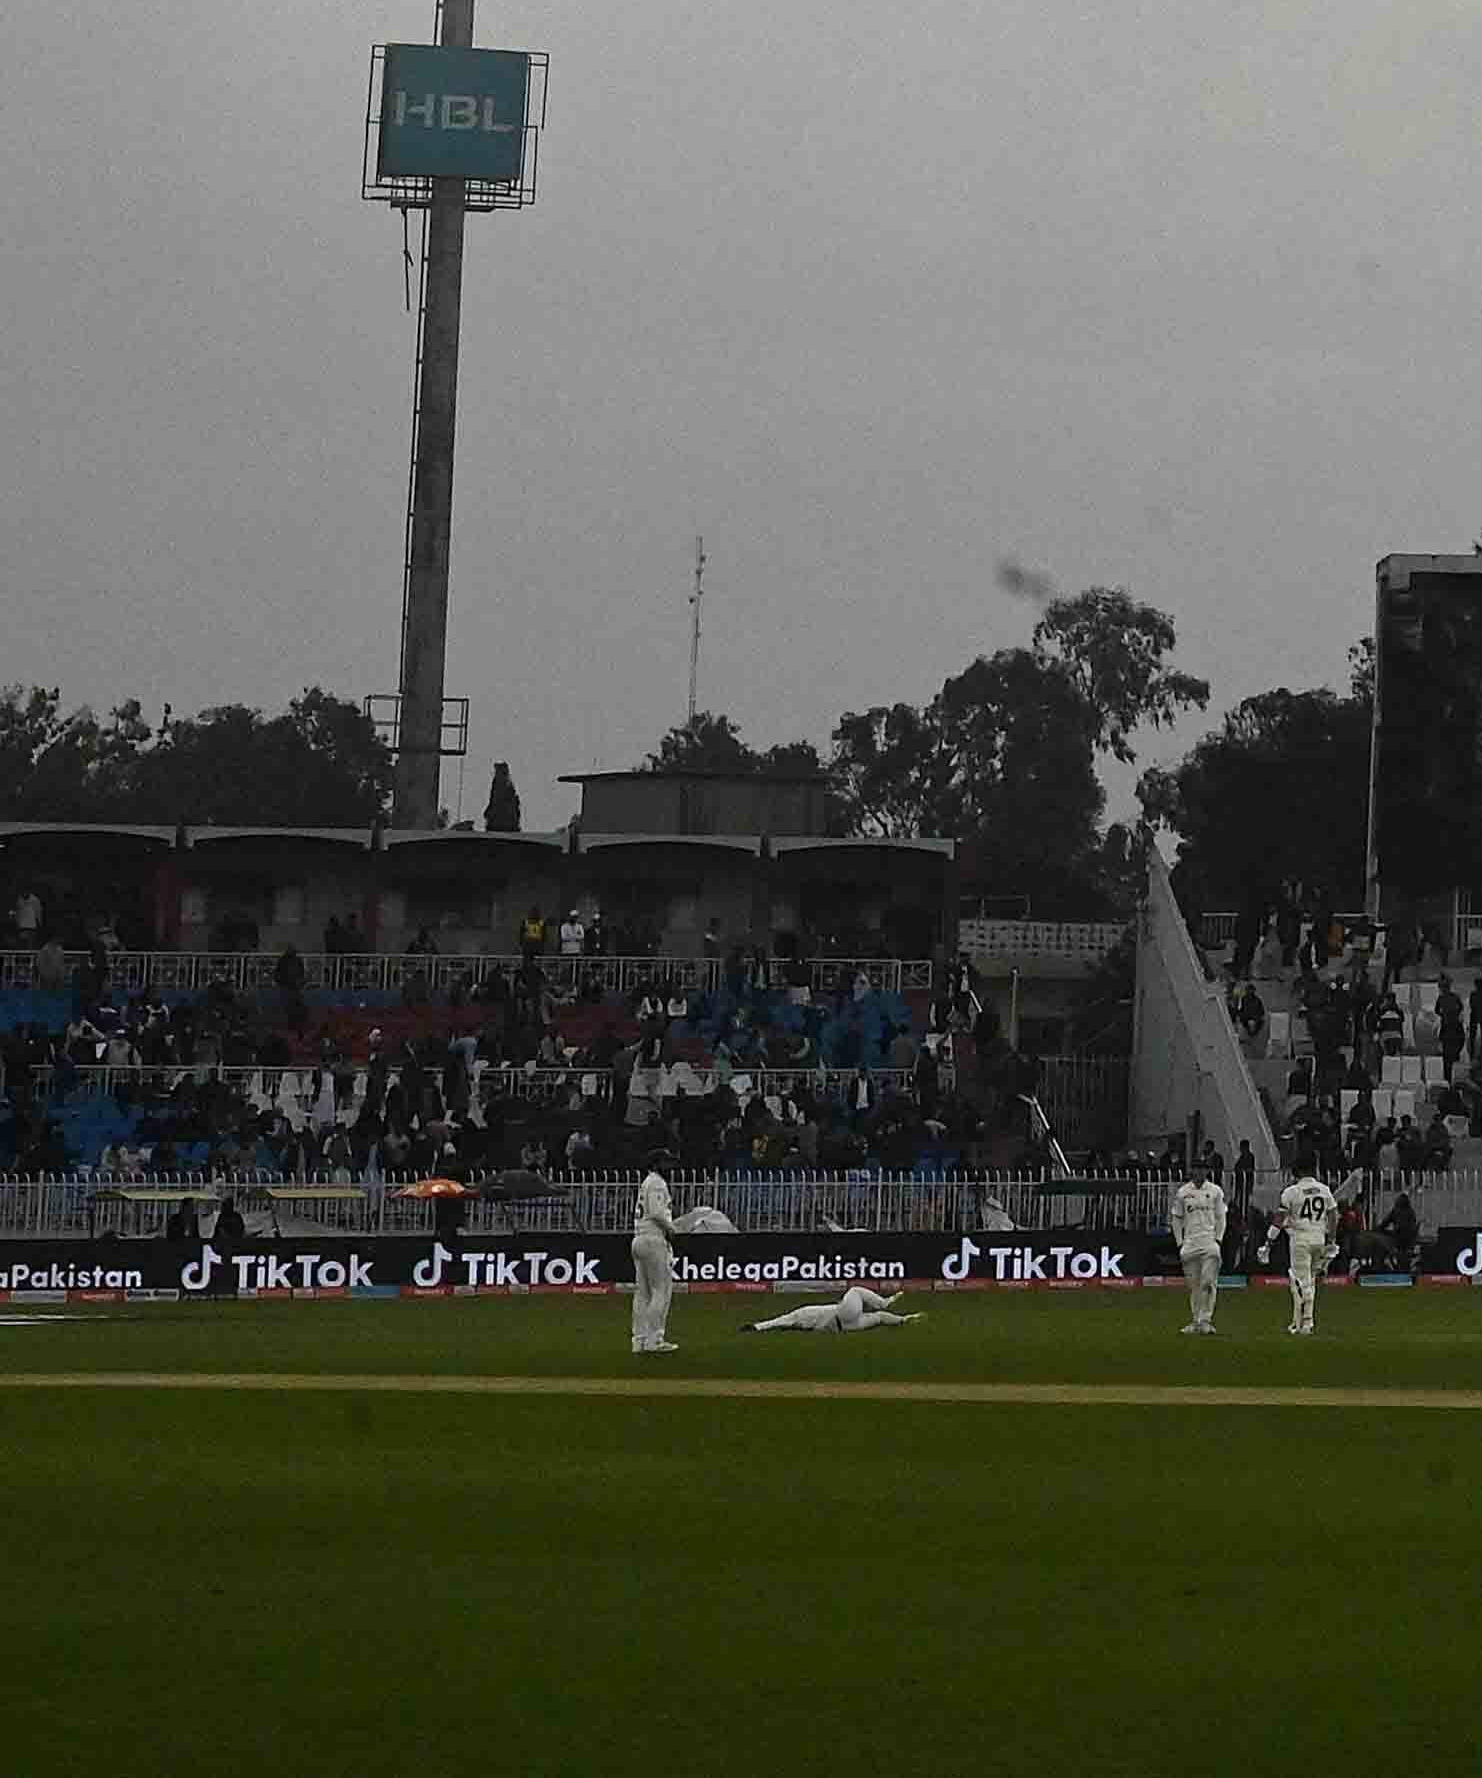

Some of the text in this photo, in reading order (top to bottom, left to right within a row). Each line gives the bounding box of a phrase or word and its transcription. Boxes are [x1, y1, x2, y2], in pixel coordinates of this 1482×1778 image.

[391, 90, 515, 134] HBL
[1301, 1196, 1325, 1221] 49
[231, 1254, 374, 1288] TikTok
[461, 1251, 600, 1285] TikTok
[669, 1255, 905, 1283] KhelegaPakistan
[988, 1246, 1125, 1279] TikTok
